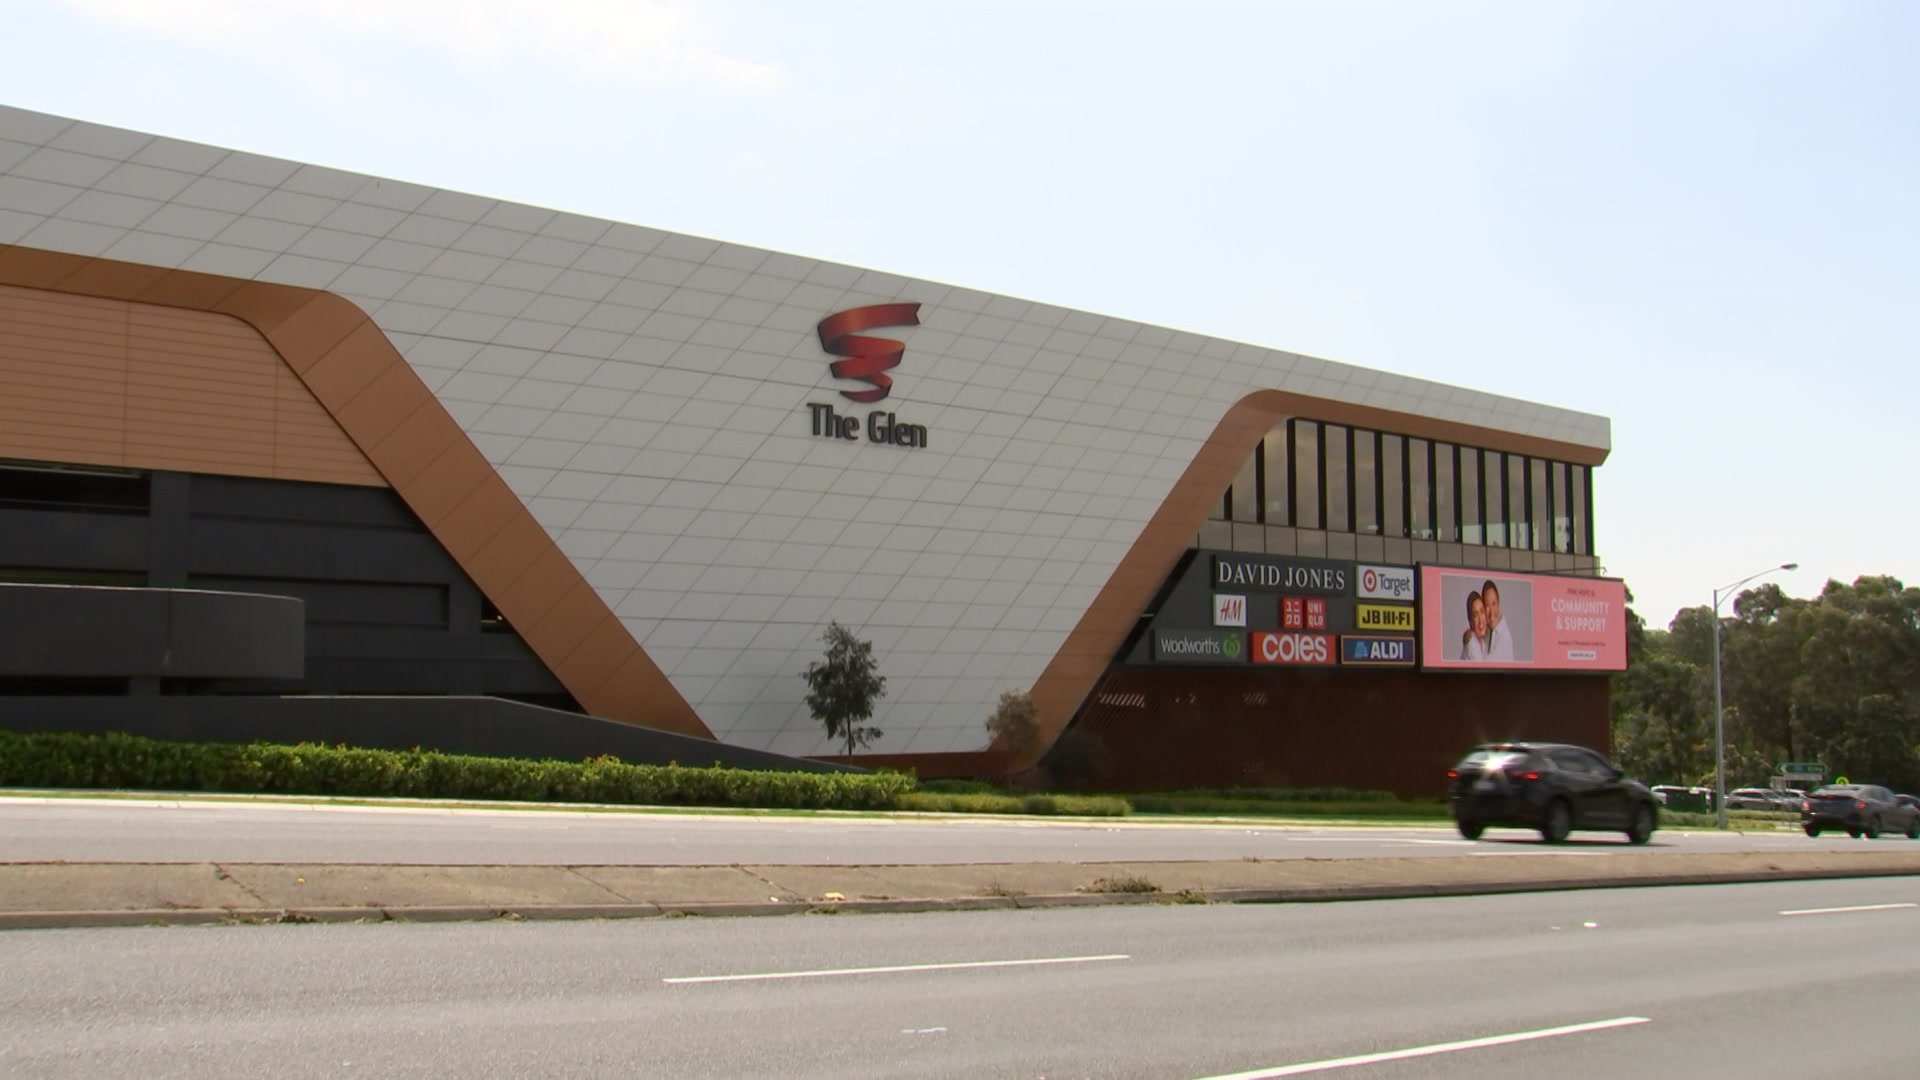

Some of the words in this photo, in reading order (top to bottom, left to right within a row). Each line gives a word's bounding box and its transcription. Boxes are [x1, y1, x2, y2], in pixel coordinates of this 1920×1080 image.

[806, 402, 860, 441] The
[867, 410, 928, 449] Glen
[1218, 561, 1281, 587] DAVID
[1284, 566, 1346, 591] JONES
[1378, 573, 1411, 597] Target
[1362, 608, 1381, 625] JB
[1551, 598, 1610, 616] COMMUNITY
[1564, 615, 1607, 633] SUPPORT
[1160, 635, 1221, 655] Woolworths
[1262, 633, 1328, 662] coles
[1370, 641, 1404, 660] ALDI
